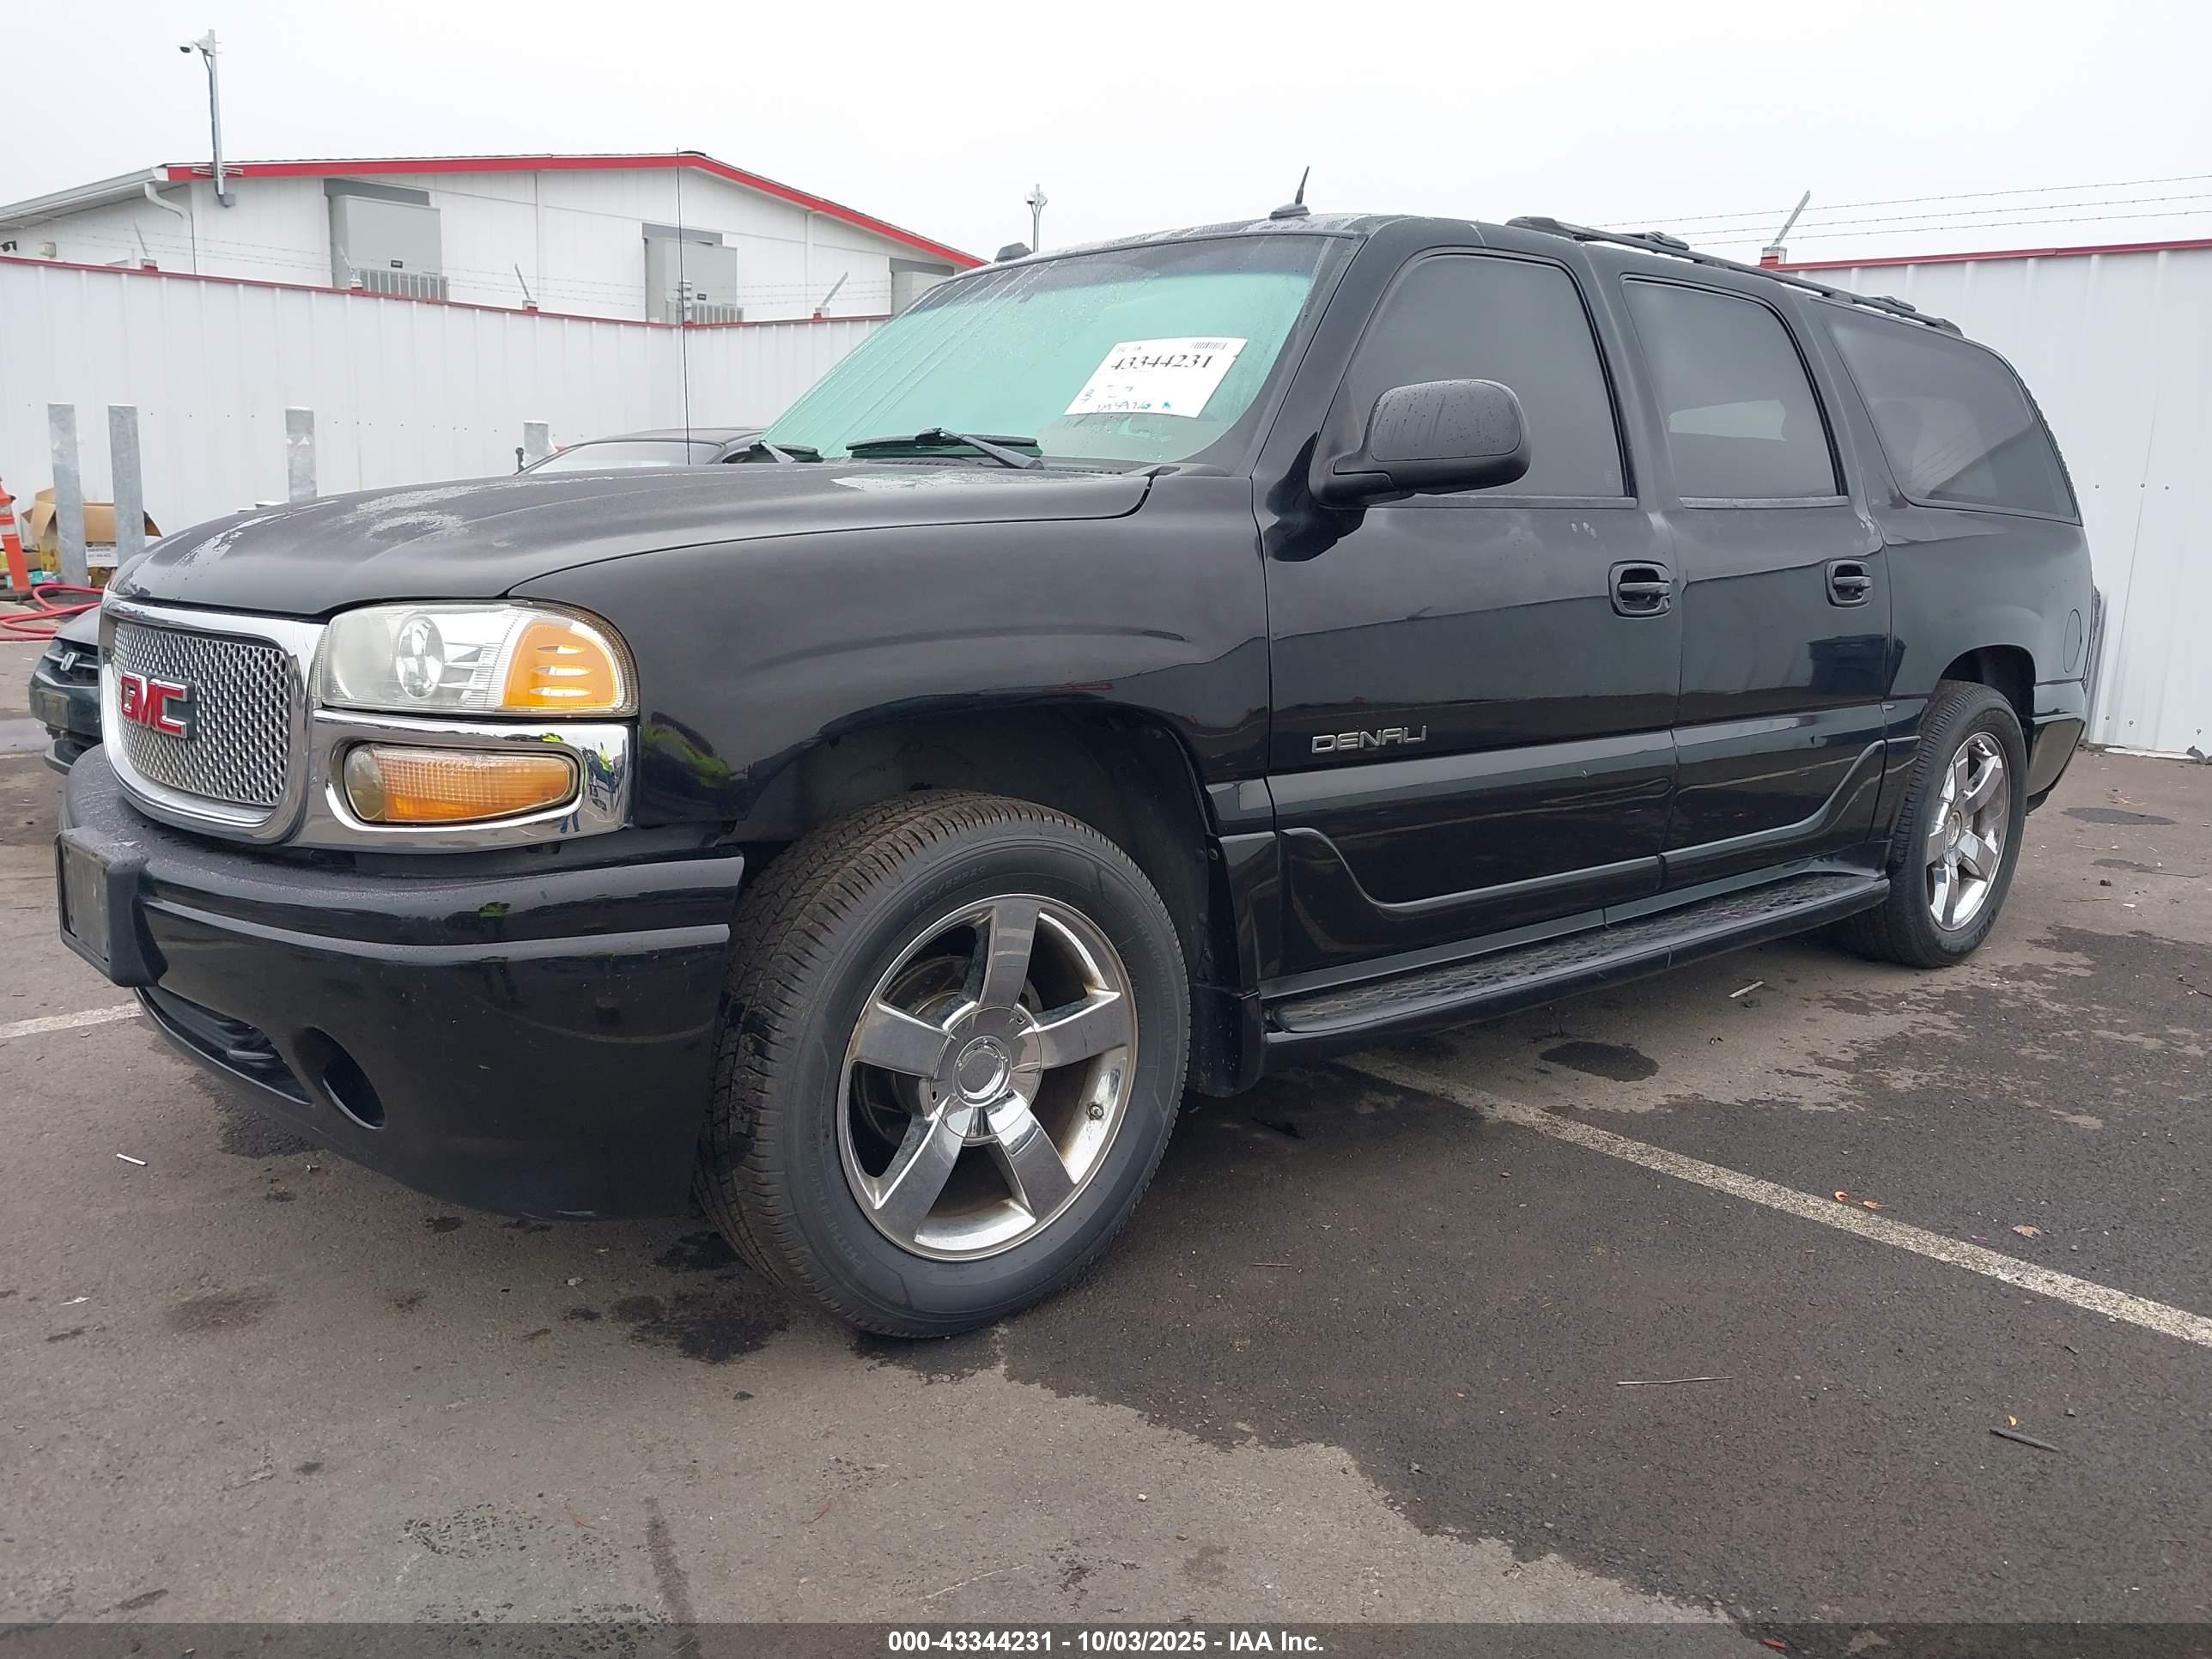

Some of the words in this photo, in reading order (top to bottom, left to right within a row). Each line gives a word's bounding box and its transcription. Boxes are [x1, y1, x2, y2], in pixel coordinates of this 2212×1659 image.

[1110, 354, 1214, 371] 43344231
[121, 669, 187, 738] GMC
[1311, 725, 1427, 754] DENALI
